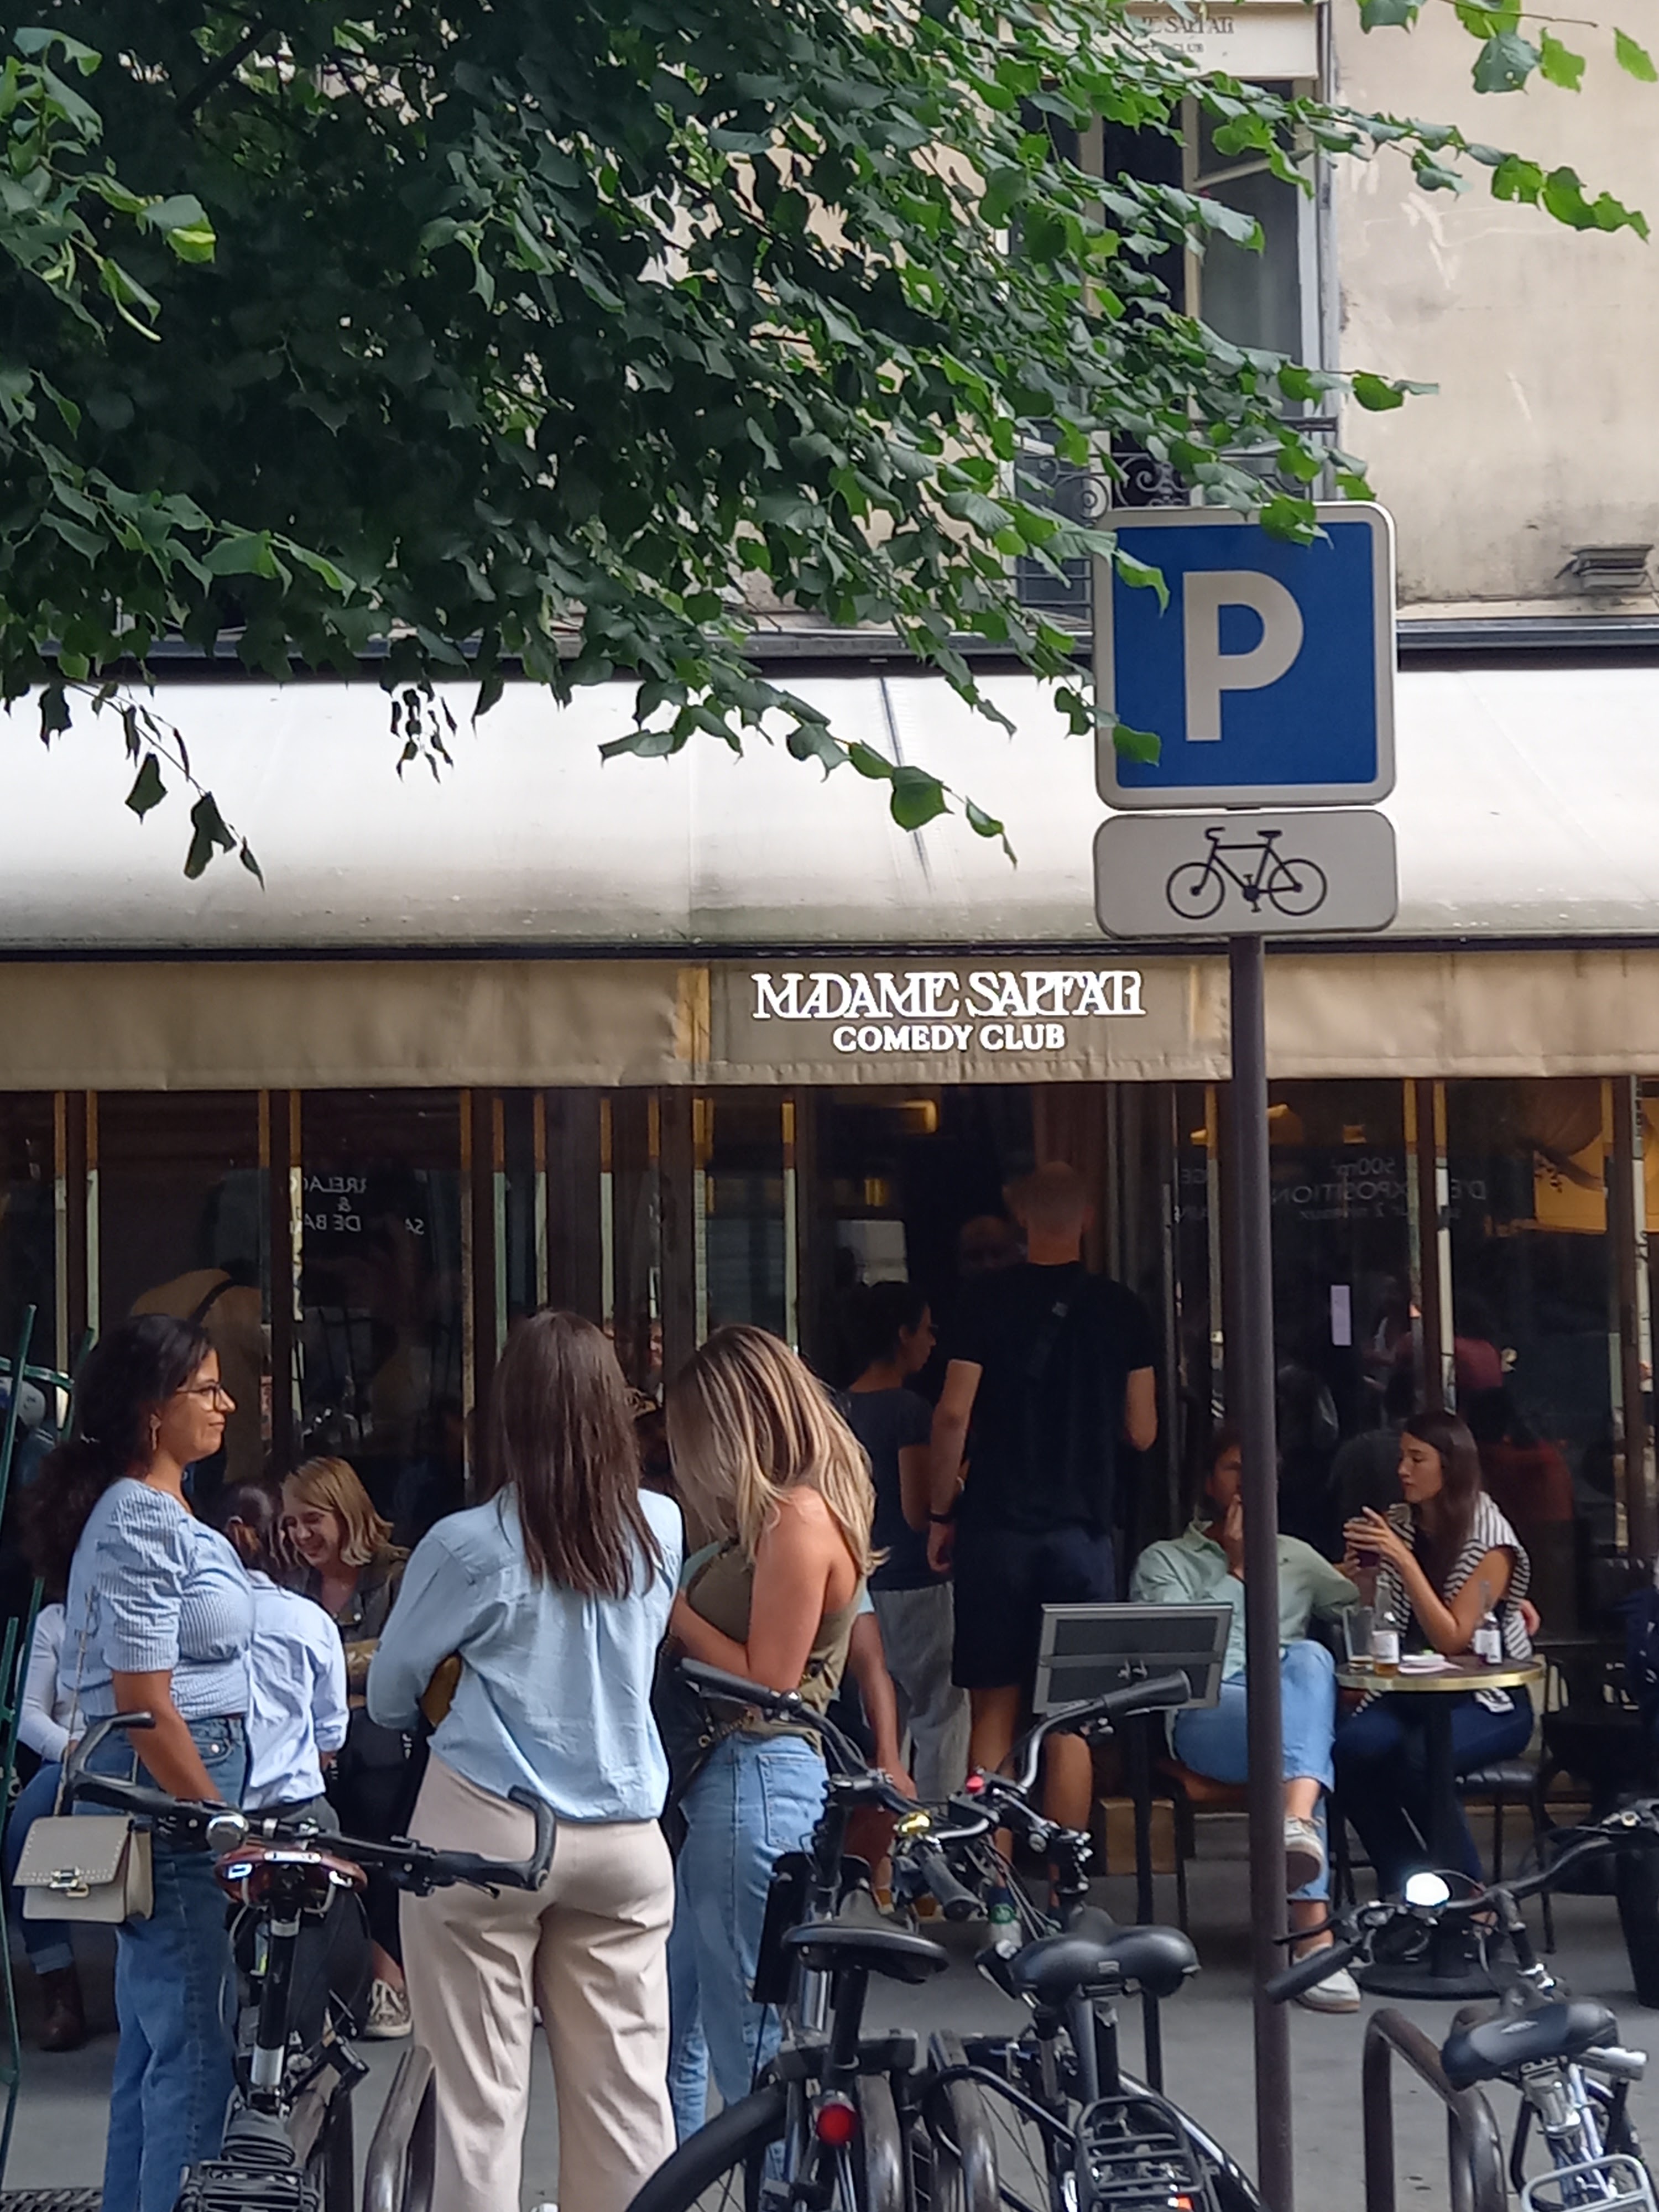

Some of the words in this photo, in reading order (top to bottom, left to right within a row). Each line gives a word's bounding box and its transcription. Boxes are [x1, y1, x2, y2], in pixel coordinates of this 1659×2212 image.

[1183, 570, 1303, 741] P
[750, 972, 960, 1018] MADAME
[833, 1025, 973, 1051] COMEDY
[980, 1024, 1065, 1050] CLUB
